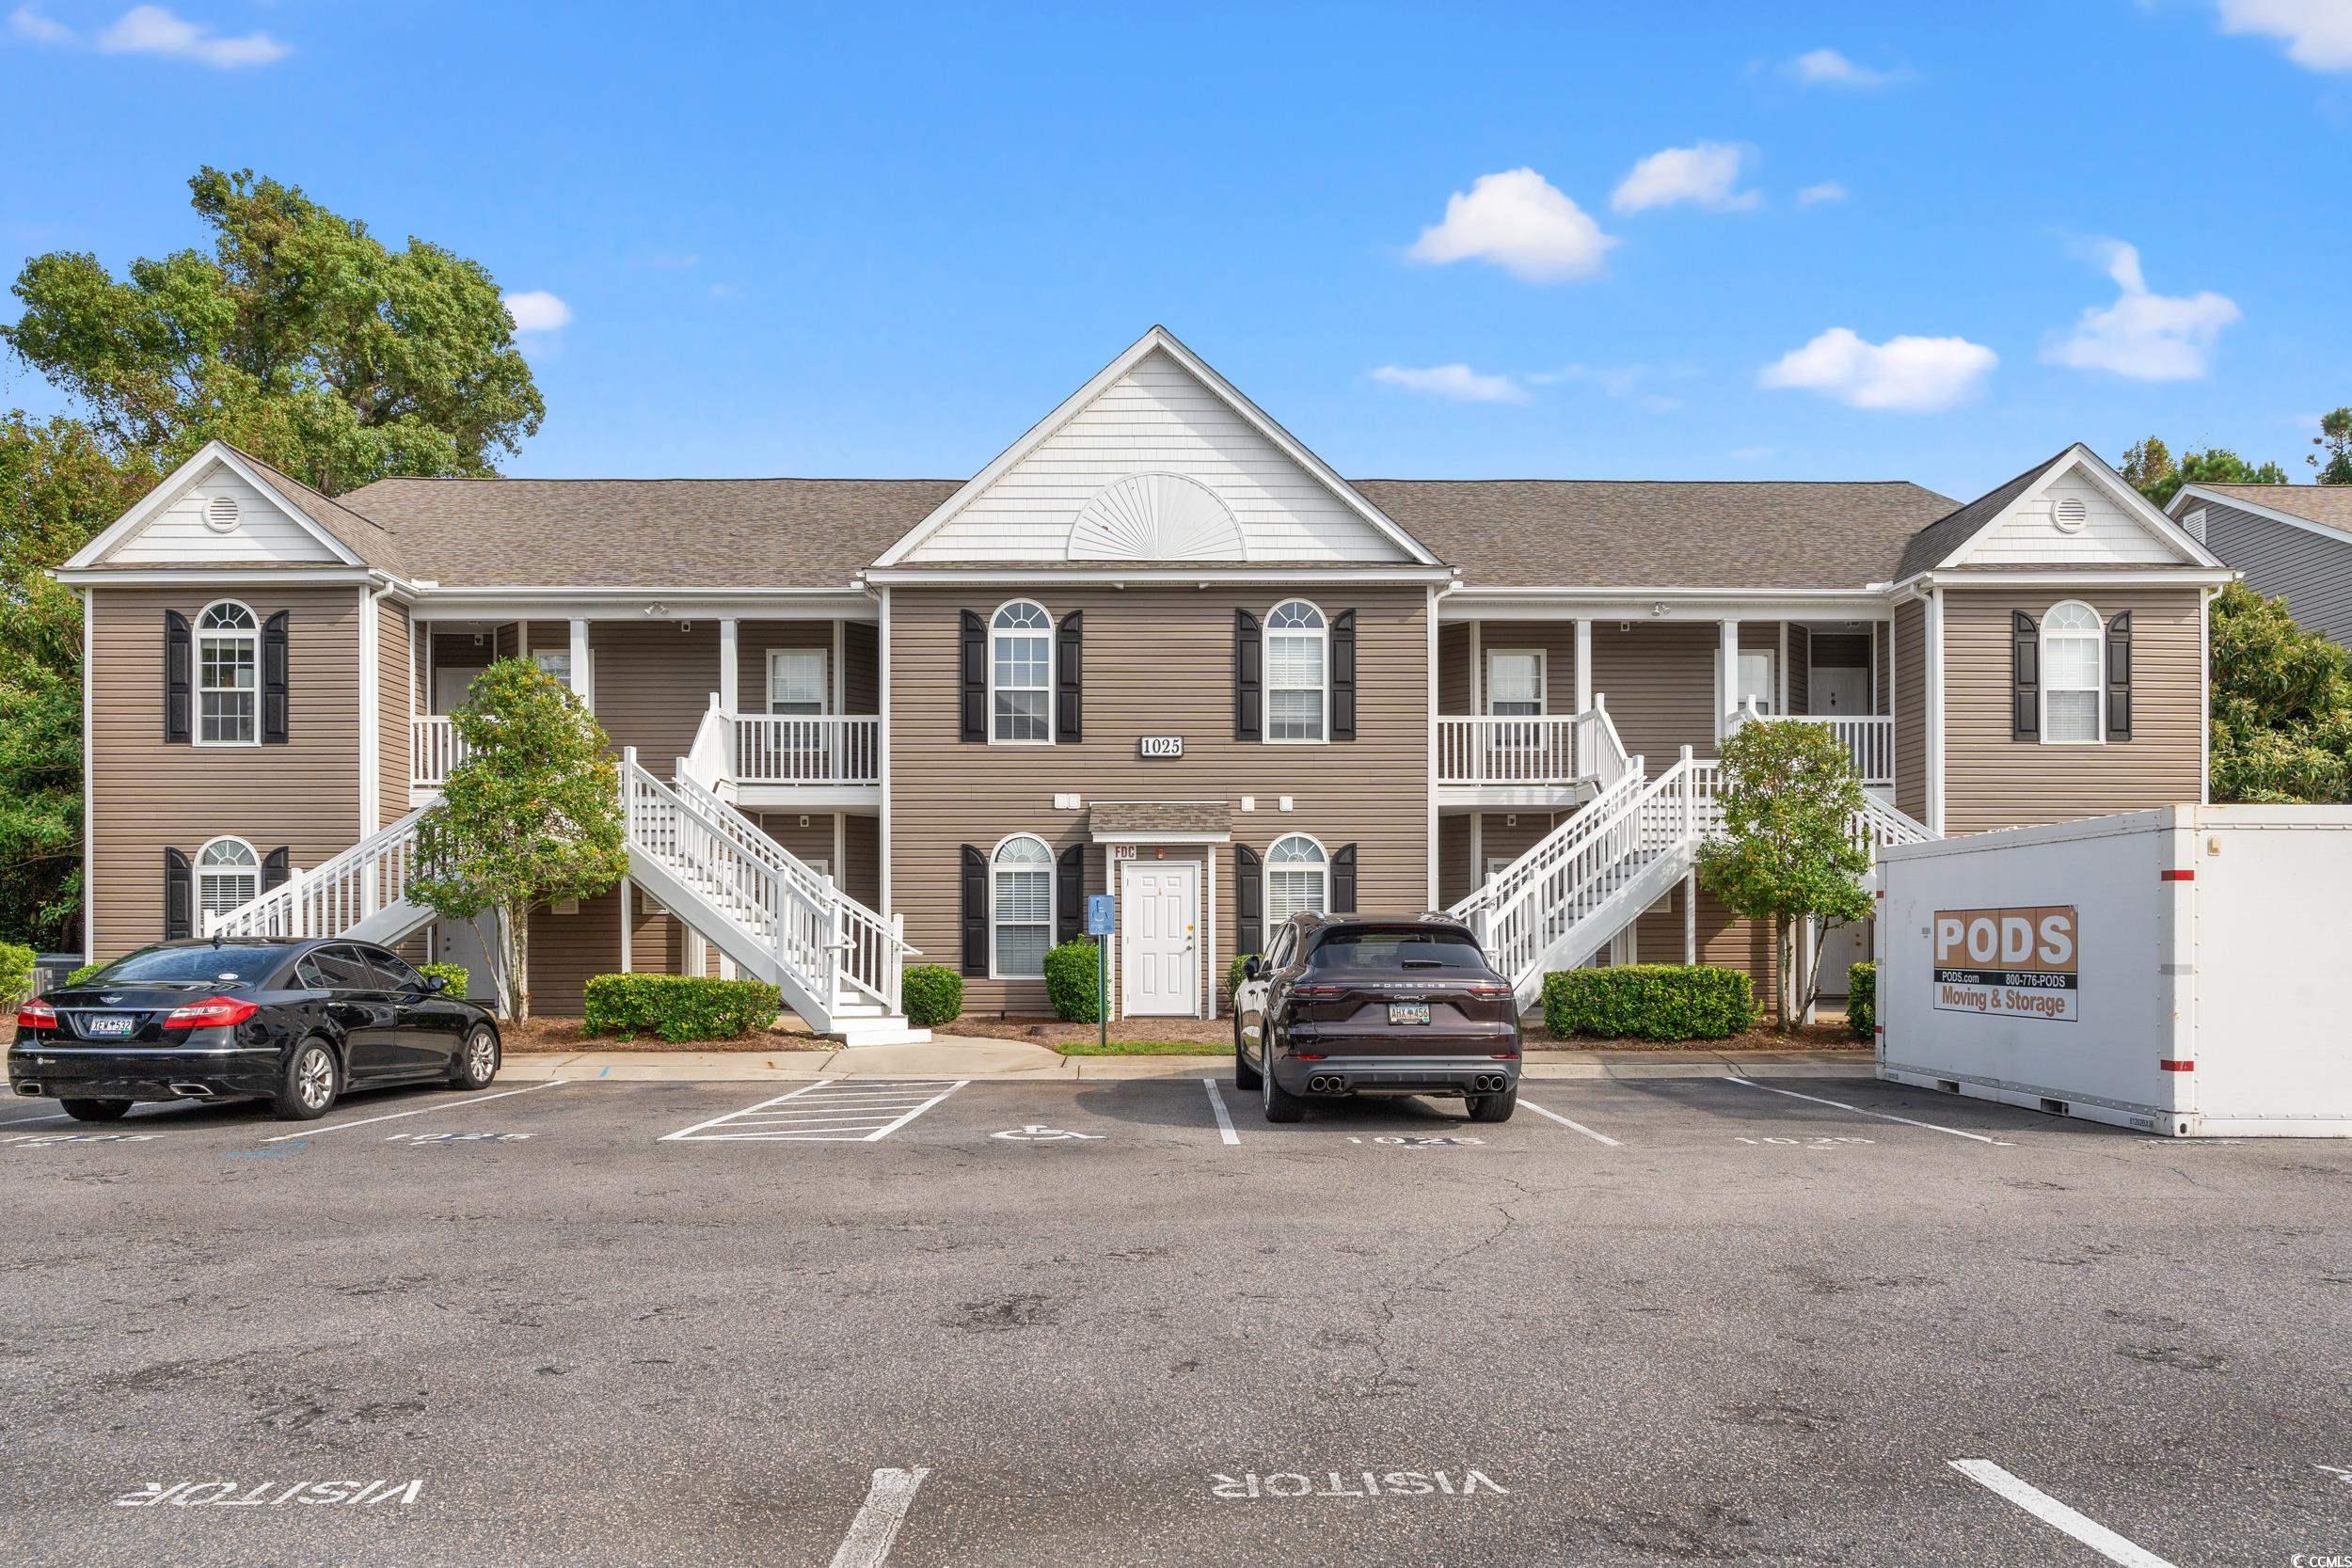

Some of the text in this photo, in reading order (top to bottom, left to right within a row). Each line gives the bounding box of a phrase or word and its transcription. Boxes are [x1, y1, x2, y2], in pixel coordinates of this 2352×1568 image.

[1143, 738, 1180, 753] 1025
[1115, 846, 1135, 858] FDC
[1937, 915, 2073, 964] PODS
[1942, 971, 2066, 988] PODS.com 800-776-PODS
[1942, 986, 2066, 1017] Moving & Storage
[1392, 1007, 1429, 1017] AHX 456
[116, 1021, 131, 1030] 532
[1211, 1470, 1510, 1497] VISITOR
[112, 1480, 424, 1506] VISITOR
